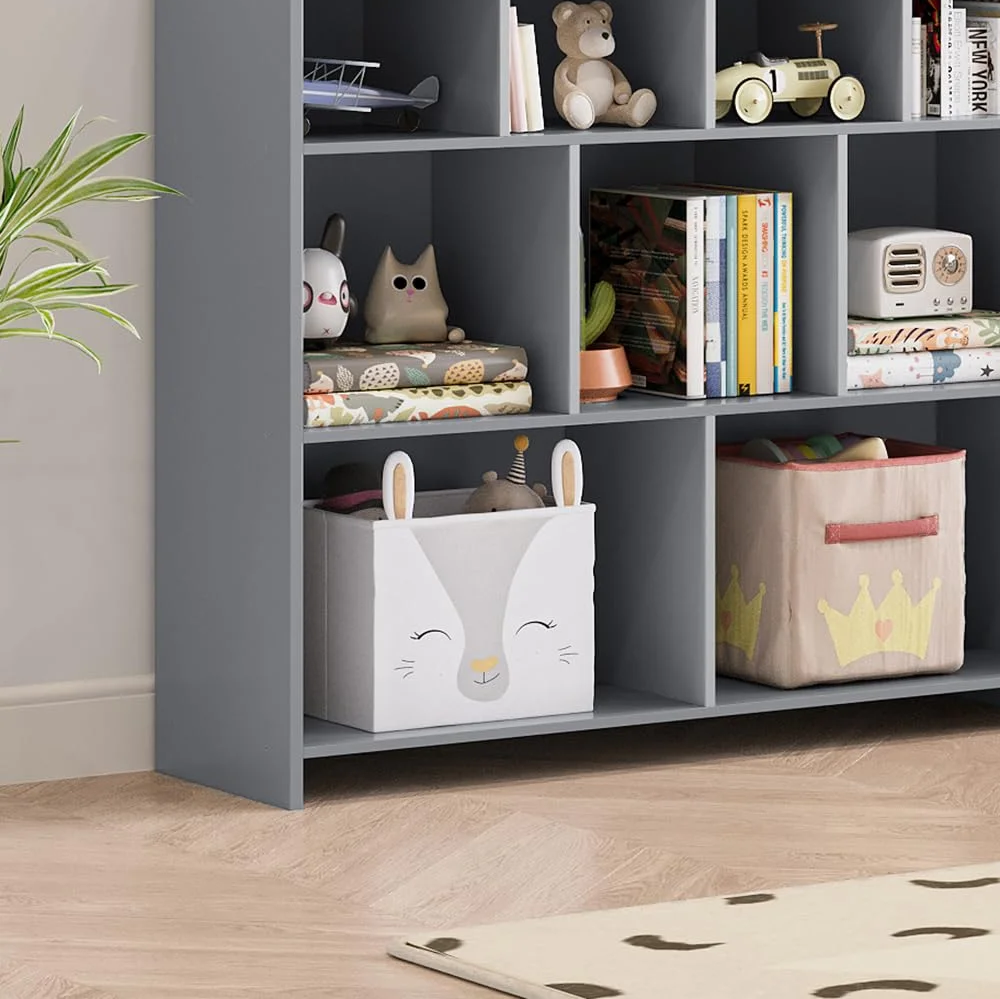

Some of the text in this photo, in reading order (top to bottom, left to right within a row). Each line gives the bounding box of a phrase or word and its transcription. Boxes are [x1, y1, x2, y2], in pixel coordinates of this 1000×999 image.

[968, 28, 988, 112] NEW YORK
[741, 210, 750, 231] SPARK
[741, 233, 749, 261] DESIGN
[761, 222, 769, 253] SMASHING
[741, 262, 749, 292] AWARDS
